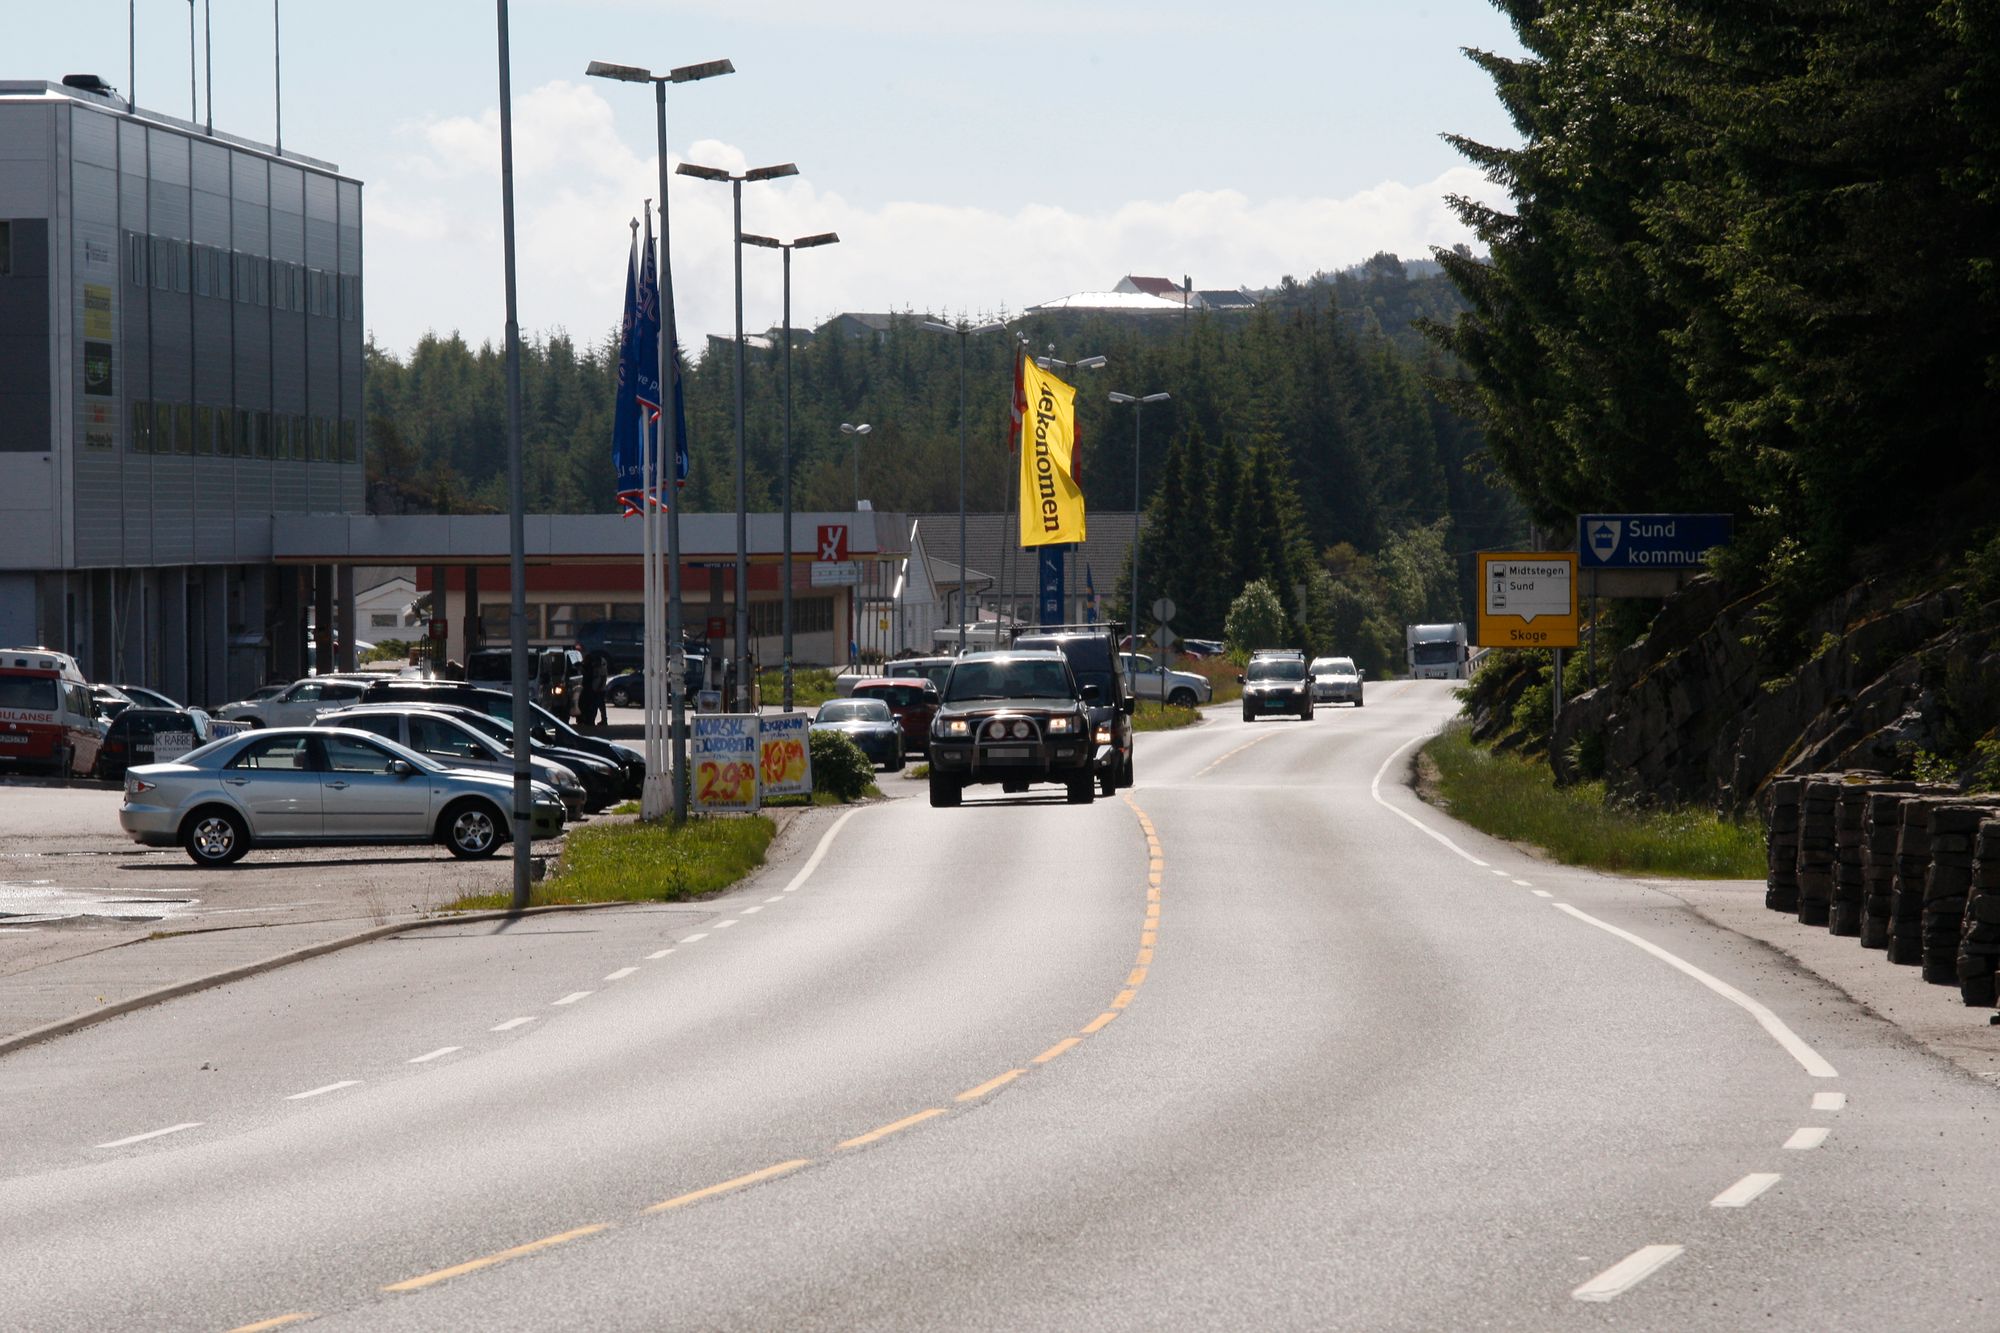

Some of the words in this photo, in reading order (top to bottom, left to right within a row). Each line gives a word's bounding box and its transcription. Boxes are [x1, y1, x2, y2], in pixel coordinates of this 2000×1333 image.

[1629, 520, 1675, 537] Sund
[1629, 547, 1705, 563] kommun
[1509, 566, 1564, 578] Midtstegen
[1510, 581, 1535, 591] Sund
[1510, 629, 1548, 642] Skoge
[0, 710, 54, 722] ULANSE
[695, 718, 746, 736] NORSKE
